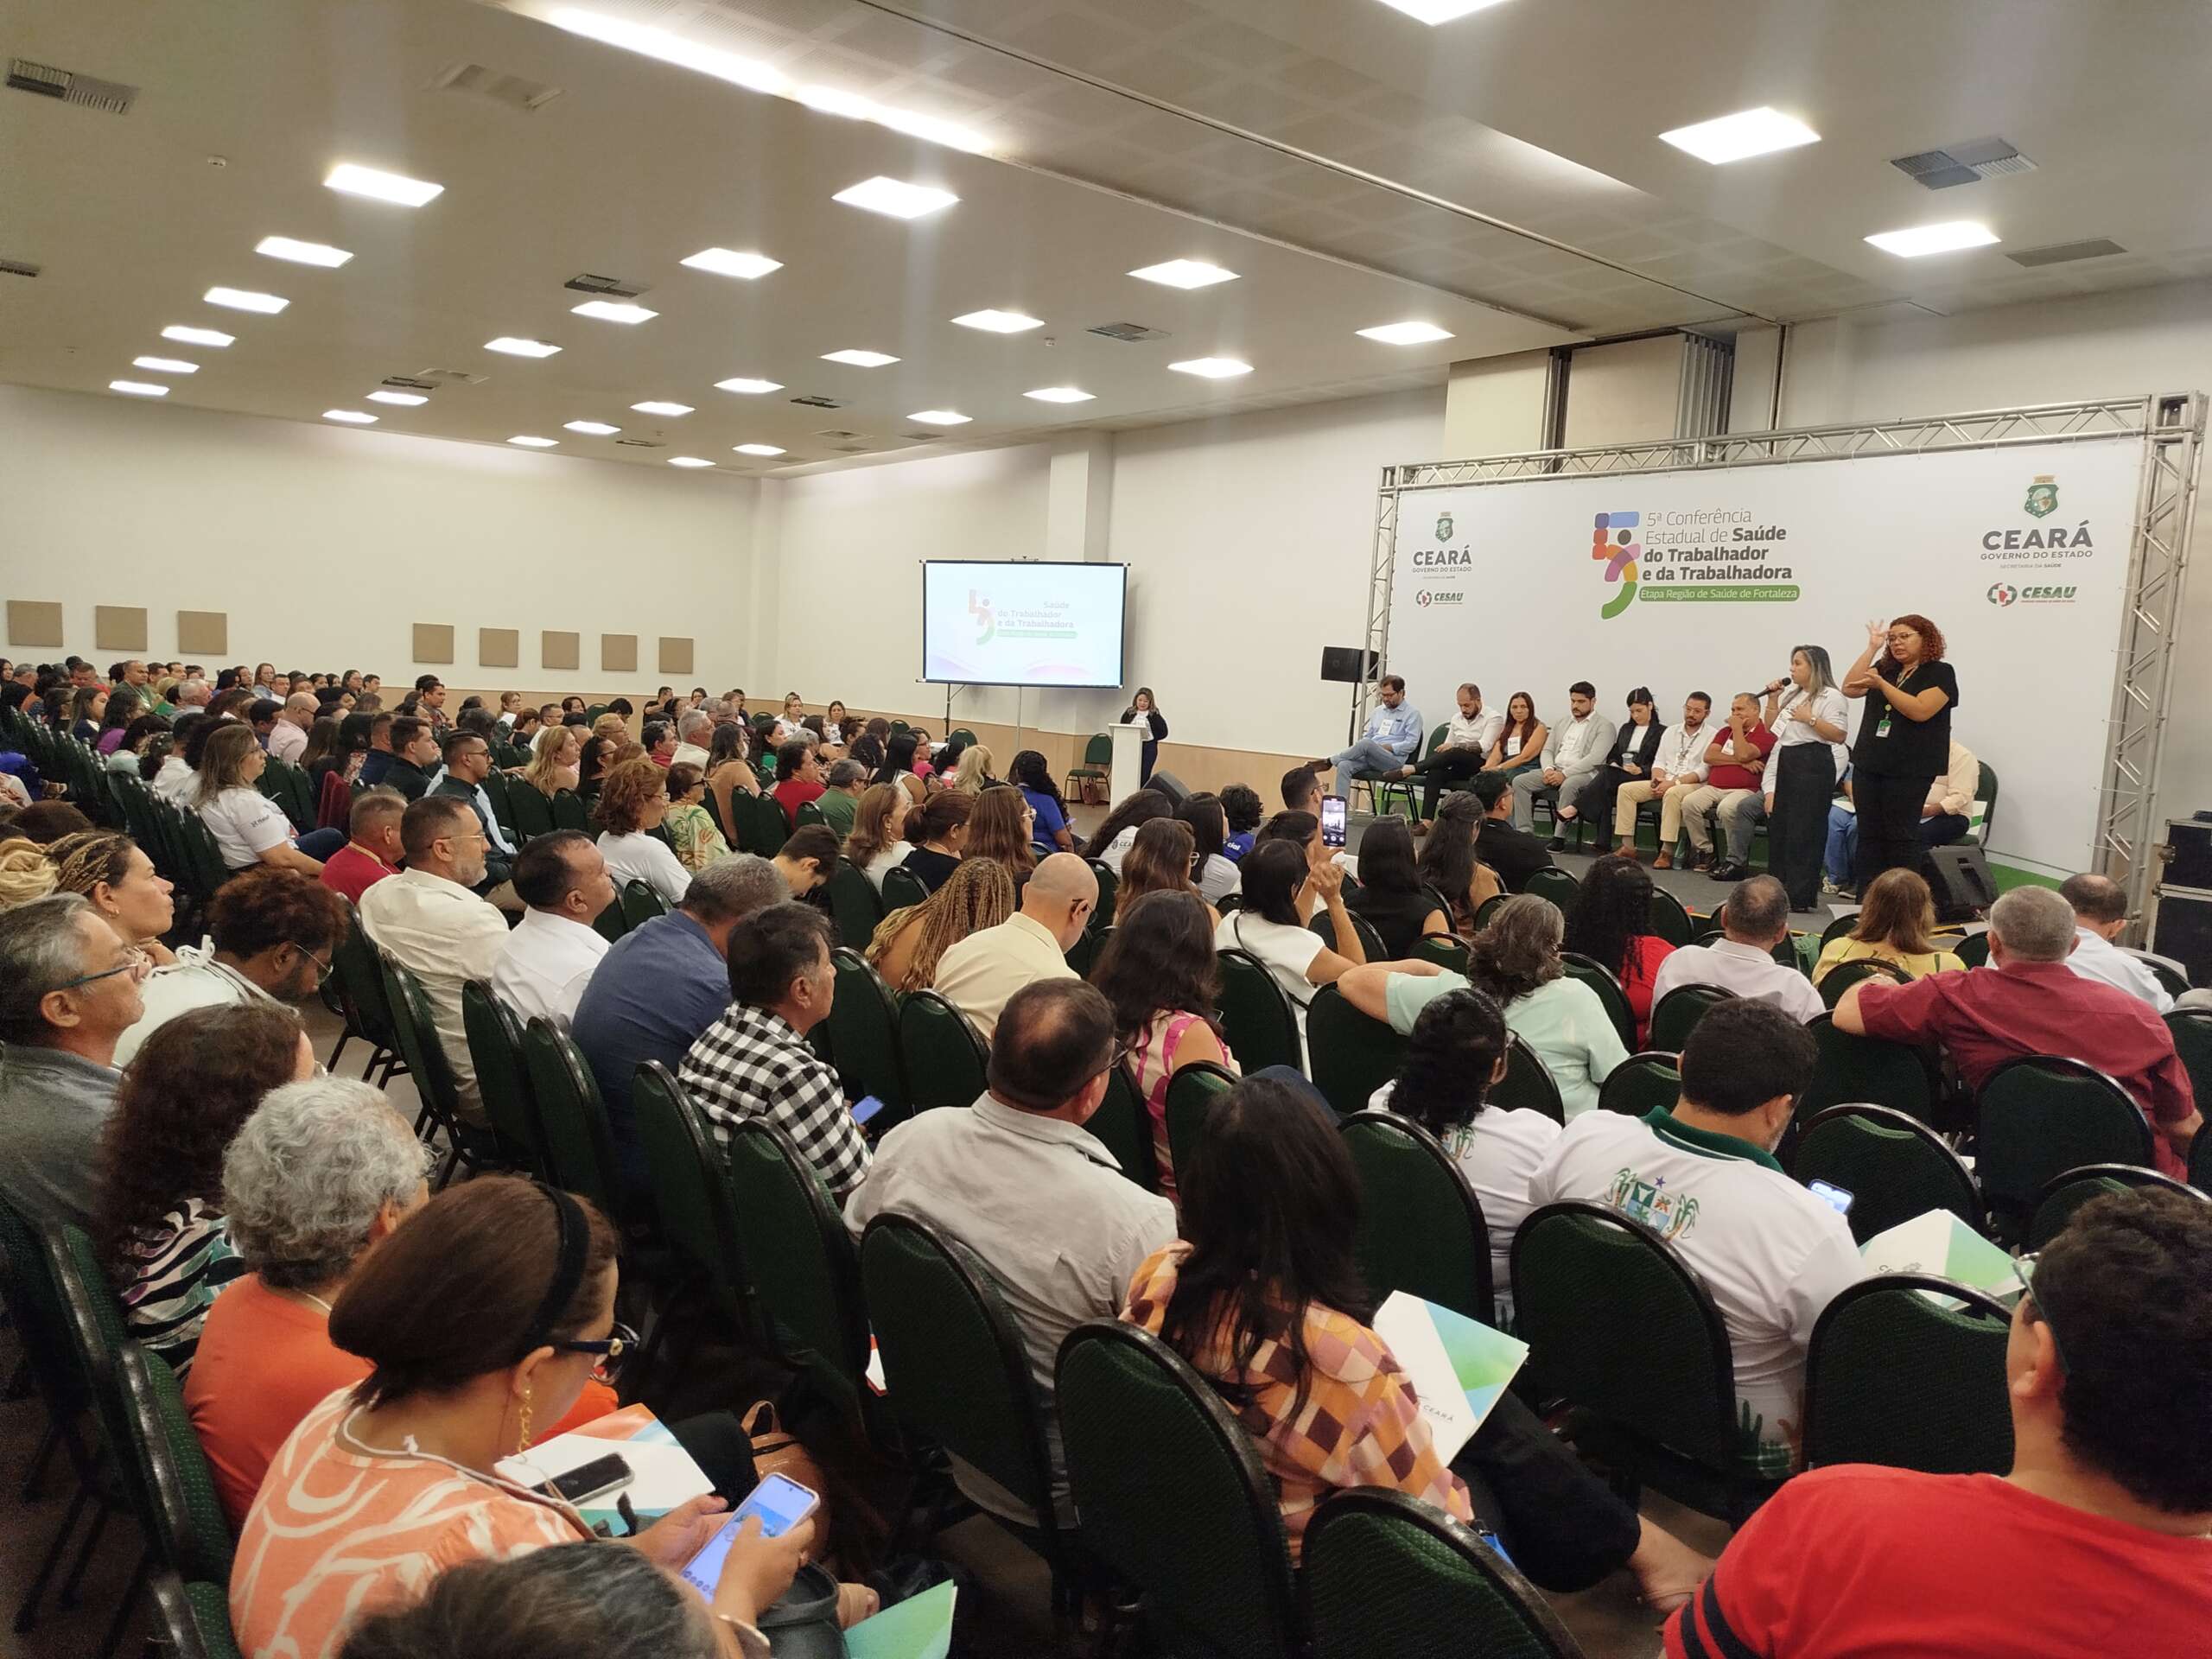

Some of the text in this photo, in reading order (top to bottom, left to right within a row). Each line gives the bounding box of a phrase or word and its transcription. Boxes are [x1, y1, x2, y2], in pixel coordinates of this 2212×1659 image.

[1666, 508, 1752, 525] Conferência
[1645, 525, 1787, 544] Estadual de Saúde
[1982, 519, 2093, 550] CEARÁ
[1414, 544, 1471, 565] CEARÁ
[1643, 546, 1769, 563] do Trabalhador
[1642, 565, 1792, 581] e da Trabalhadora
[1434, 592, 1464, 601] CESAU
[1641, 588, 1797, 600] Etapa Região de Saúde de Fortaleza
[2022, 587, 2077, 598] CESAU
[1011, 609, 1062, 618] Trabalhador
[1017, 620, 1075, 628] Trabalhadora
